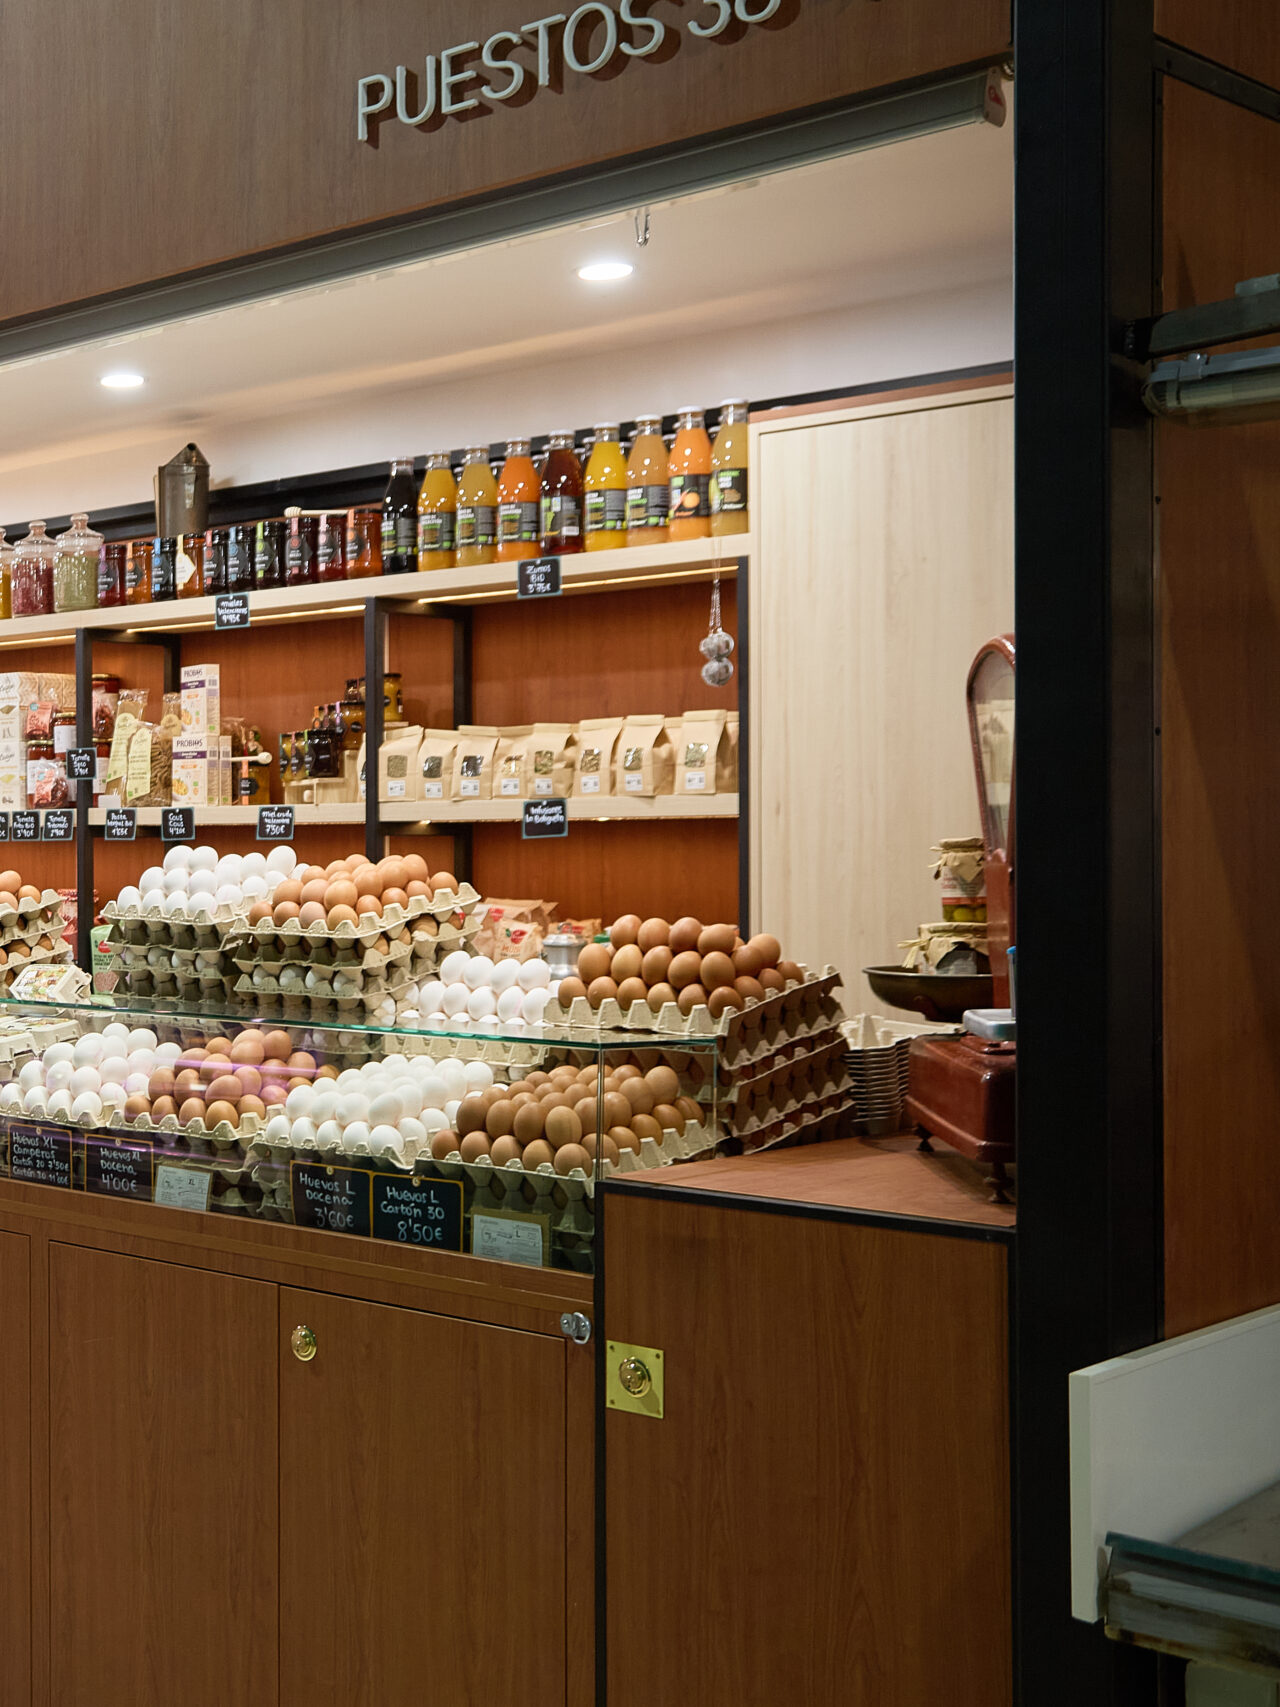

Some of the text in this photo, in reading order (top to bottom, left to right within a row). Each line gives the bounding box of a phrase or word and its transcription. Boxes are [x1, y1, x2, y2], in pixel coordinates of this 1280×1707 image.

[357, 0, 666, 141] PUESTOS
[12, 1130, 58, 1150] Huevos XL
[13, 1143, 56, 1160] Camperos
[100, 1147, 143, 1163] Huevos XL
[99, 1159, 138, 1176] Docena
[101, 1172, 139, 1193] 4'00€
[298, 1171, 356, 1195] Huevos L
[305, 1188, 353, 1207] Docena
[386, 1185, 440, 1205] Huevos L
[313, 1206, 355, 1229] 3'60€
[380, 1200, 446, 1221] Cartón 30
[396, 1218, 444, 1243] 8'50€
